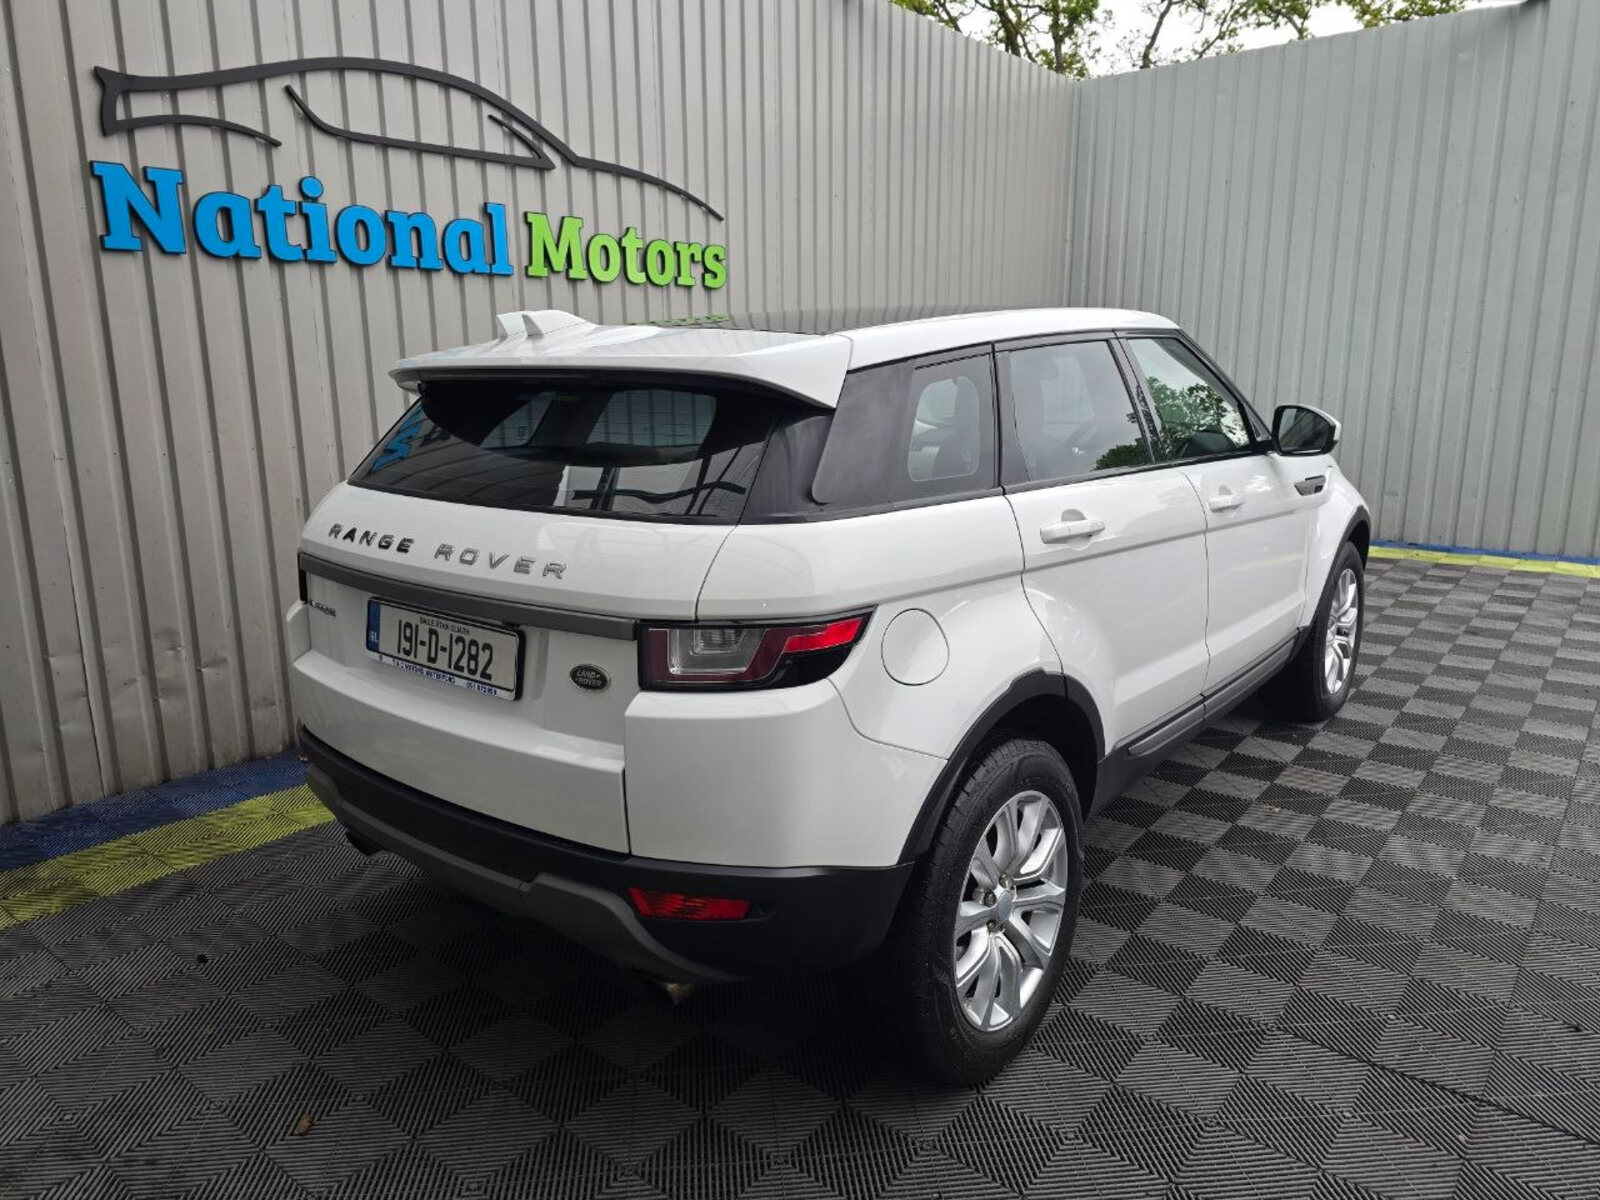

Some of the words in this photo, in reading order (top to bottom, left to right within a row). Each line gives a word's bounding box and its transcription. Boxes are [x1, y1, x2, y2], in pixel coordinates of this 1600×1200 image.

[91, 160, 513, 277] National
[525, 210, 727, 289] Motors
[328, 523, 414, 553] RANGE
[434, 543, 567, 580] ROVER
[397, 619, 493, 681] 191-D-1282
[577, 669, 596, 679] LAND
